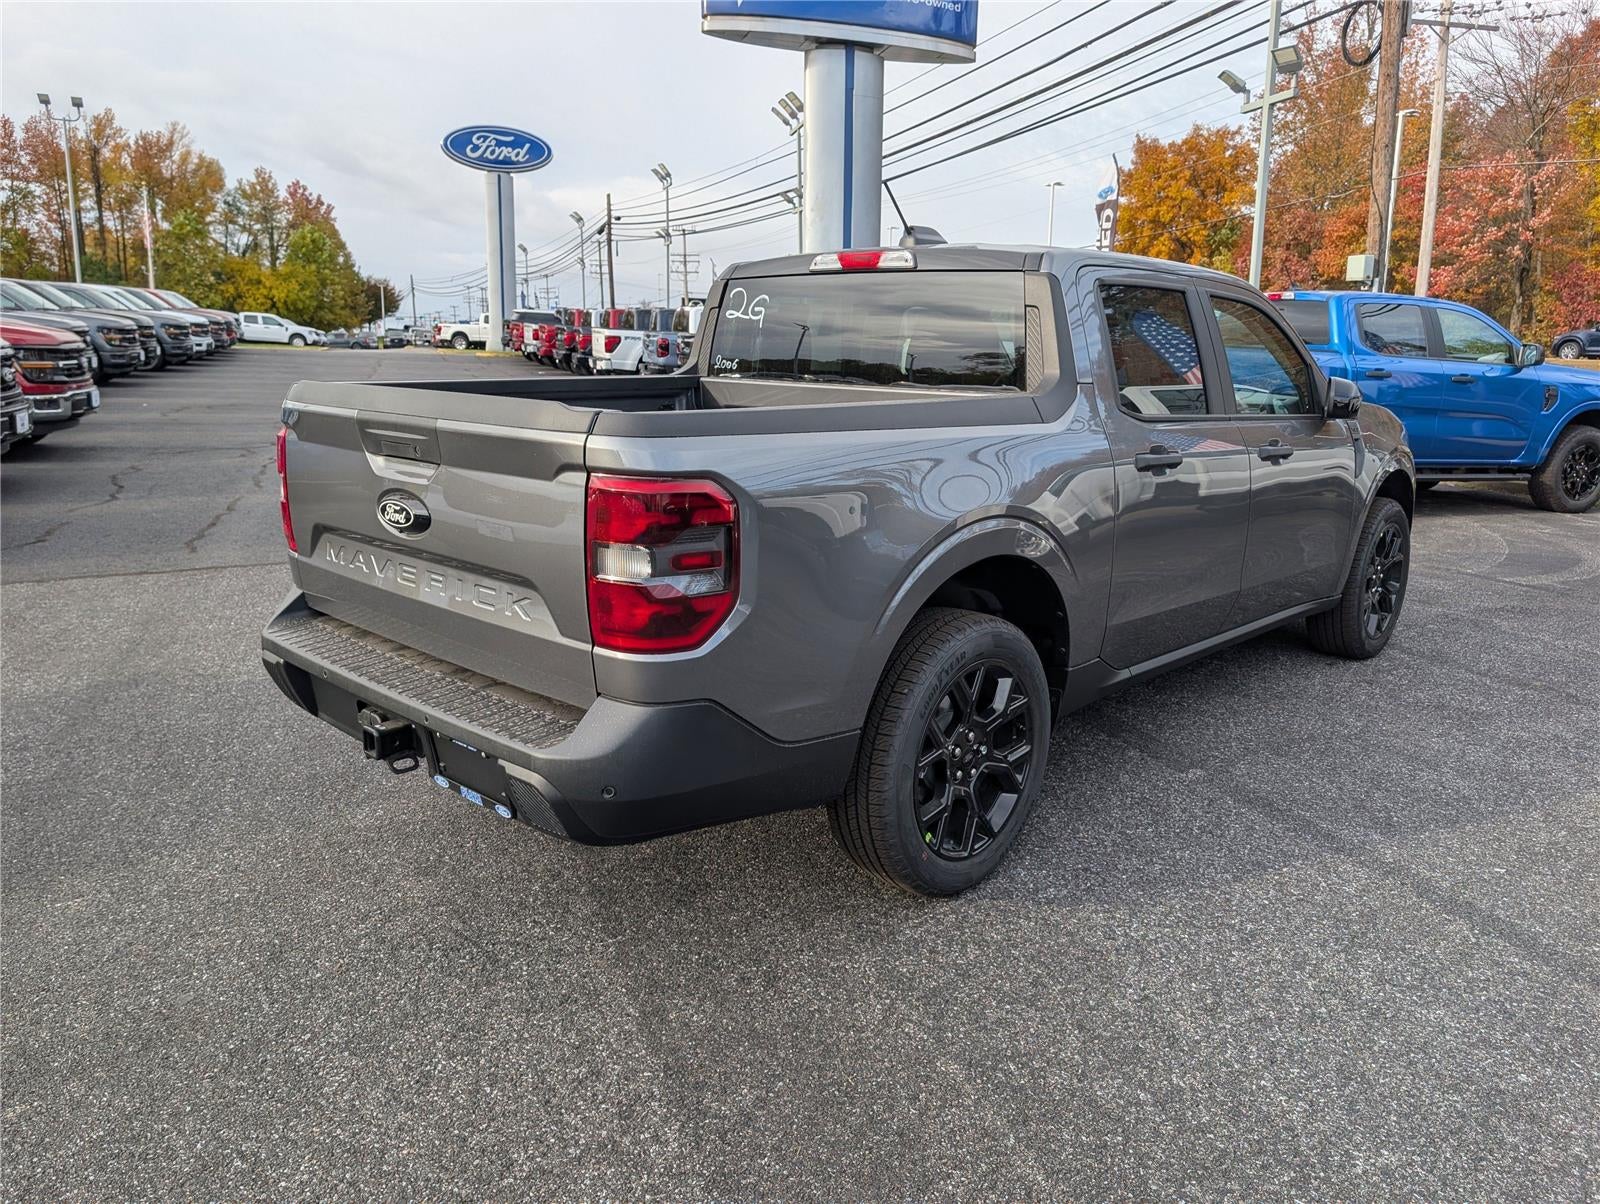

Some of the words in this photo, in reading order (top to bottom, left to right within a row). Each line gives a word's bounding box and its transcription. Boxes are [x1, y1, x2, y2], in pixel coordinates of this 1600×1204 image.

[466, 132, 530, 161] Ford
[384, 503, 407, 524] Ford
[326, 542, 532, 622] MAVERICK
